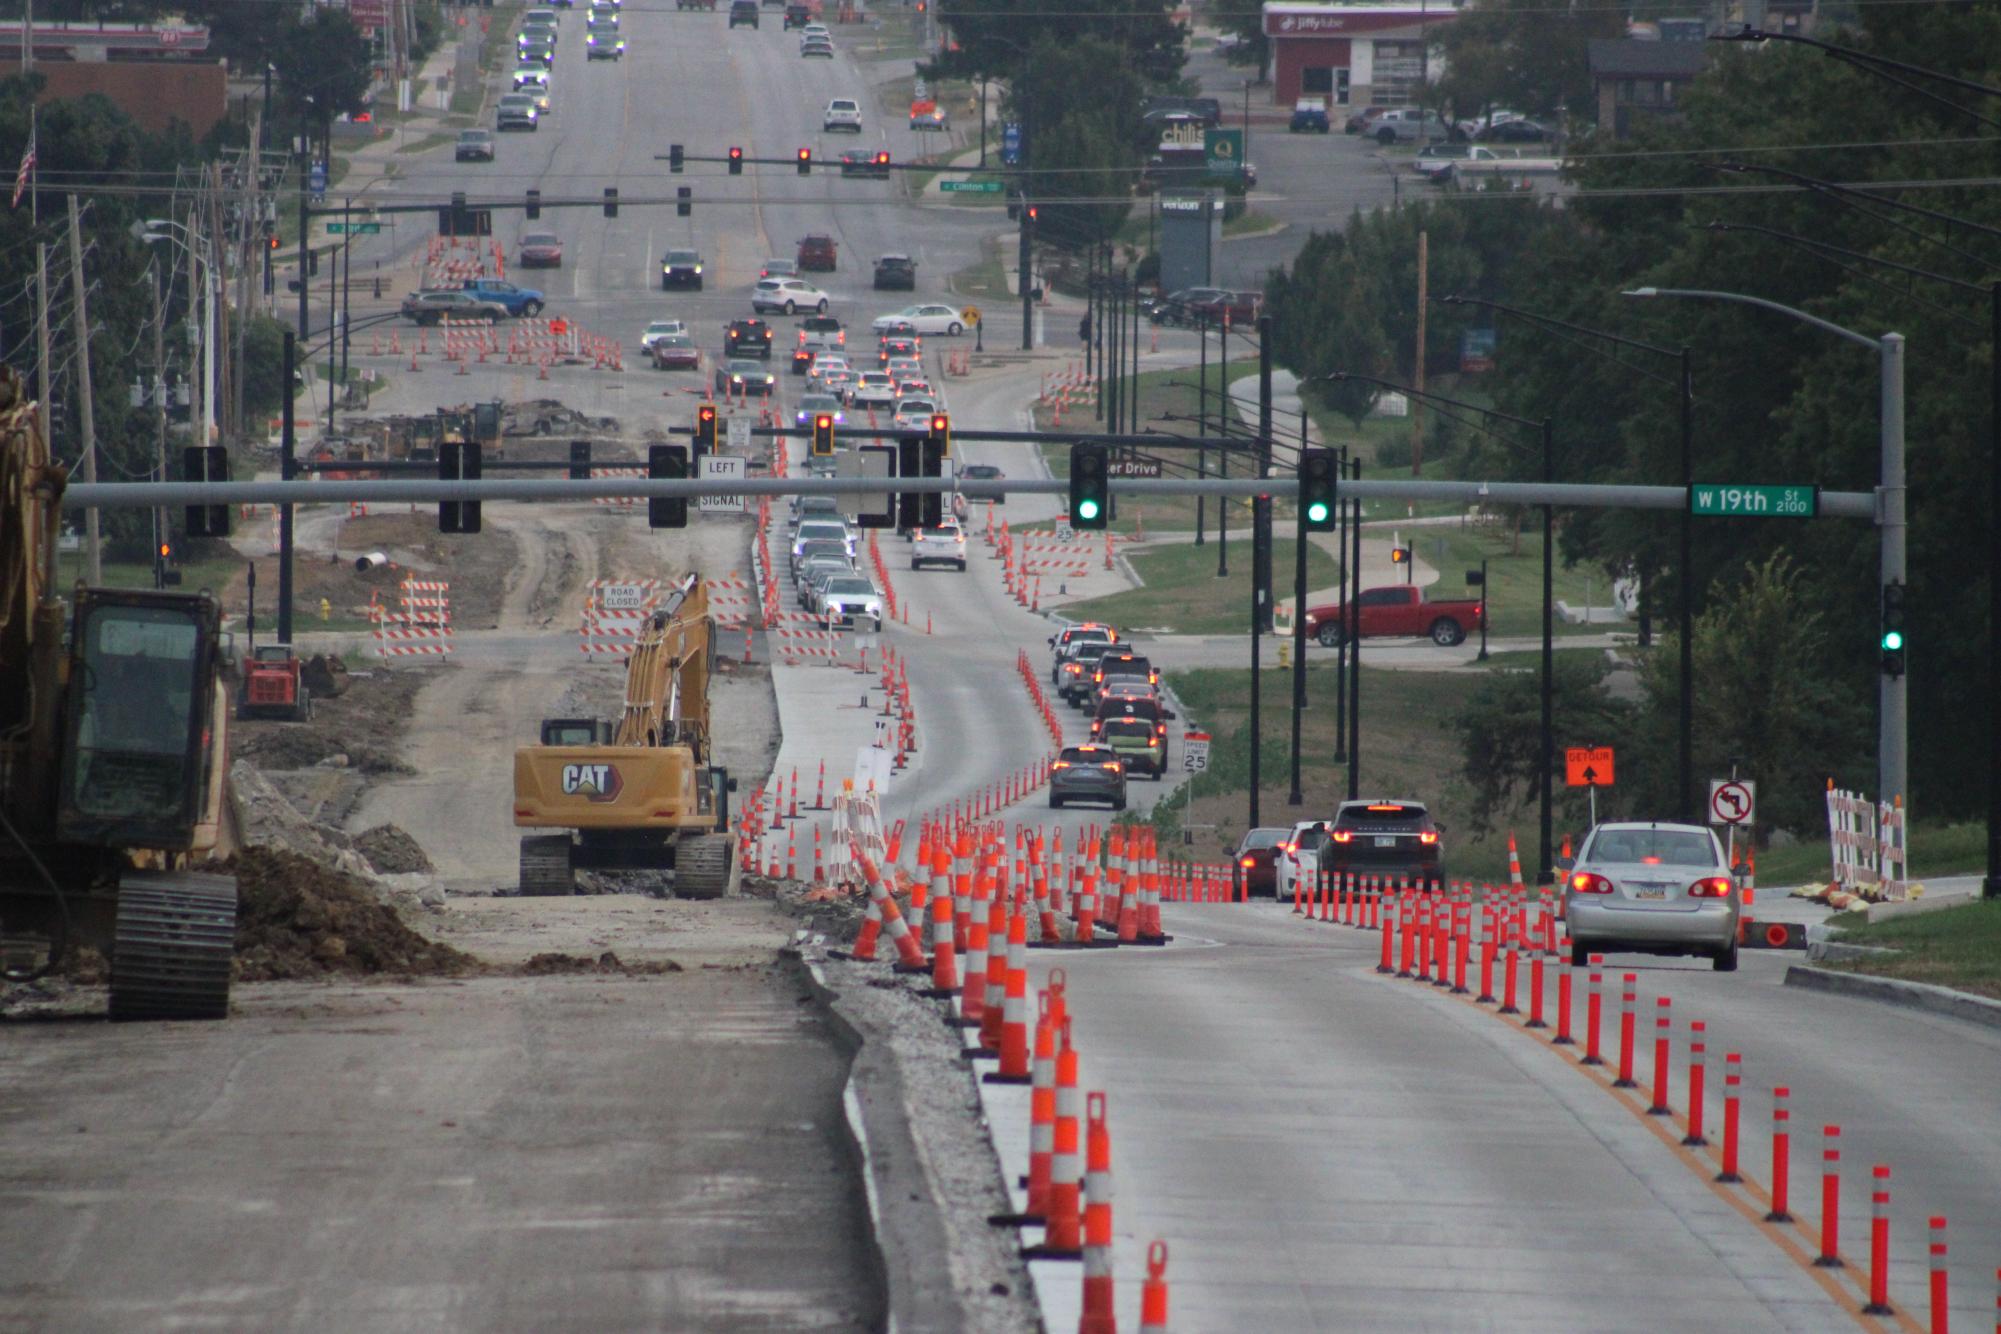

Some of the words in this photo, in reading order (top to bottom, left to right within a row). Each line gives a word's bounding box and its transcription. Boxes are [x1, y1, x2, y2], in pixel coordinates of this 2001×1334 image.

[709, 463, 735, 473] LEFT
[1125, 462, 1157, 475] Drive
[702, 495, 742, 506] SIGNAL
[1698, 491, 1713, 508] W
[1719, 489, 1768, 511] 19th
[1784, 490, 1799, 500] St
[1776, 501, 1807, 513] 2100
[610, 588, 634, 596] ROAD
[606, 598, 639, 606] CLOSED
[1185, 755, 1206, 769] 25
[1568, 752, 1610, 761] DETOUR
[563, 765, 609, 794] CAT
